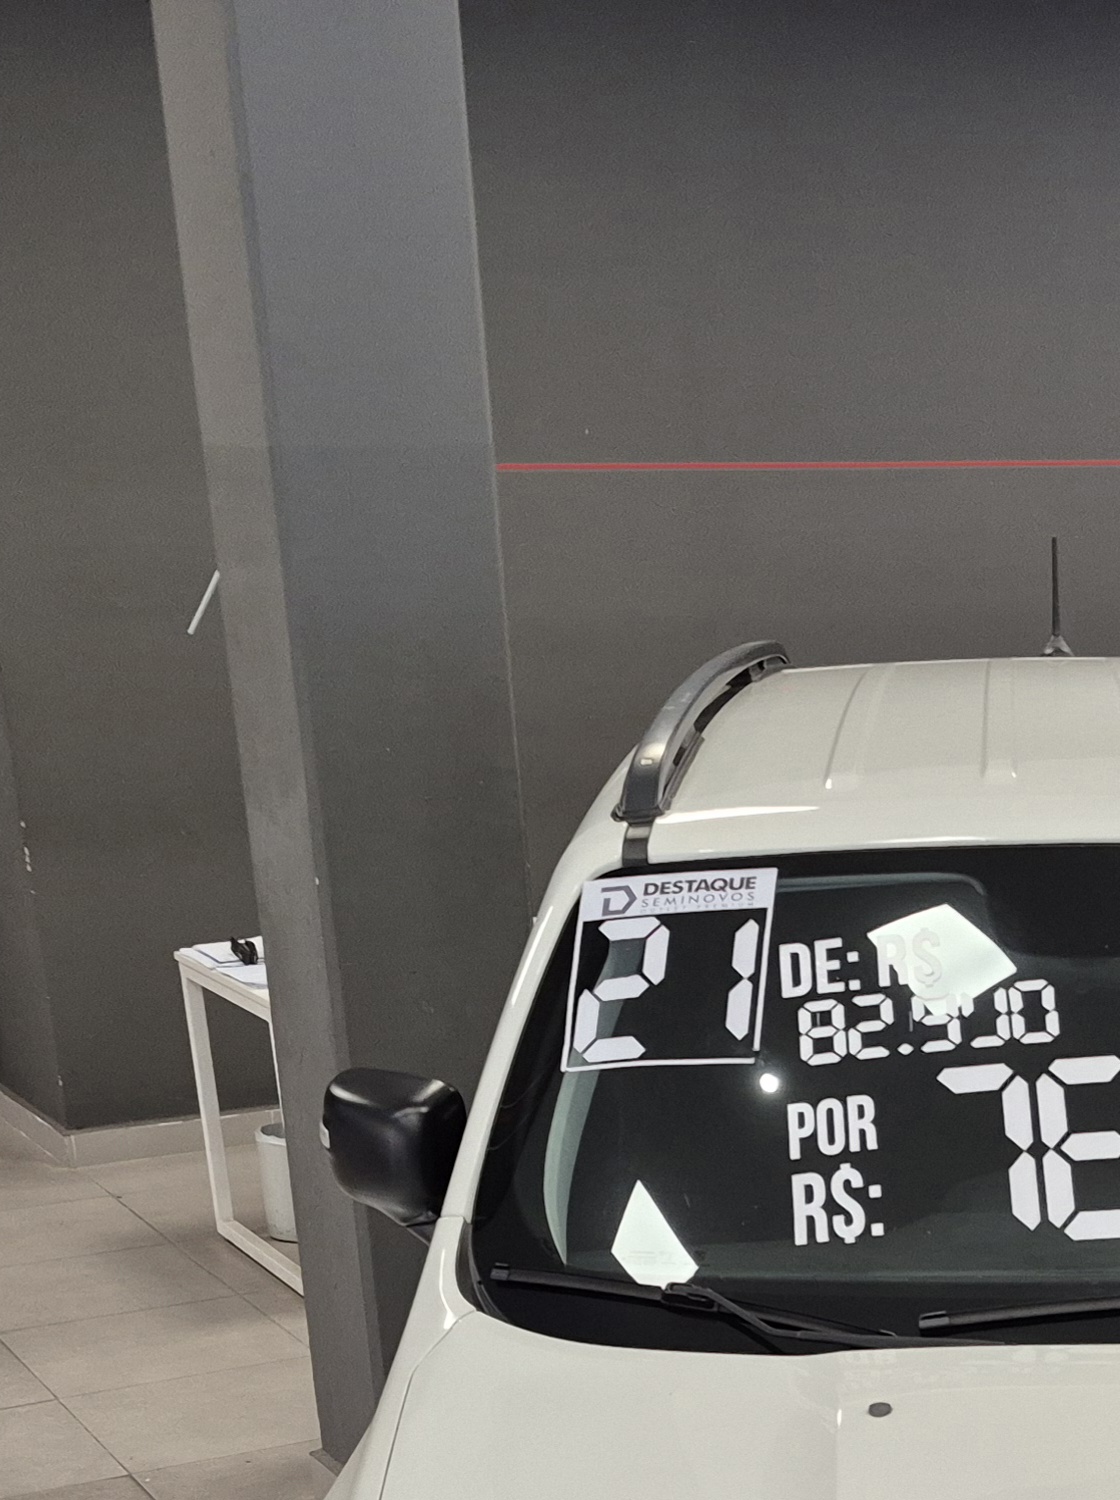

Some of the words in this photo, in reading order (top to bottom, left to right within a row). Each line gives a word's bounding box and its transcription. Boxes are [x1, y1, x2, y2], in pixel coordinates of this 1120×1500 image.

[641, 891, 756, 908] SEMINOVOS
[643, 876, 757, 897] DESTAQUE
[573, 916, 759, 1063] 21
[778, 937, 861, 999] DE:
[876, 927, 943, 987] R$
[787, 1094, 878, 1161] POR
[791, 1163, 885, 1246] R$:
